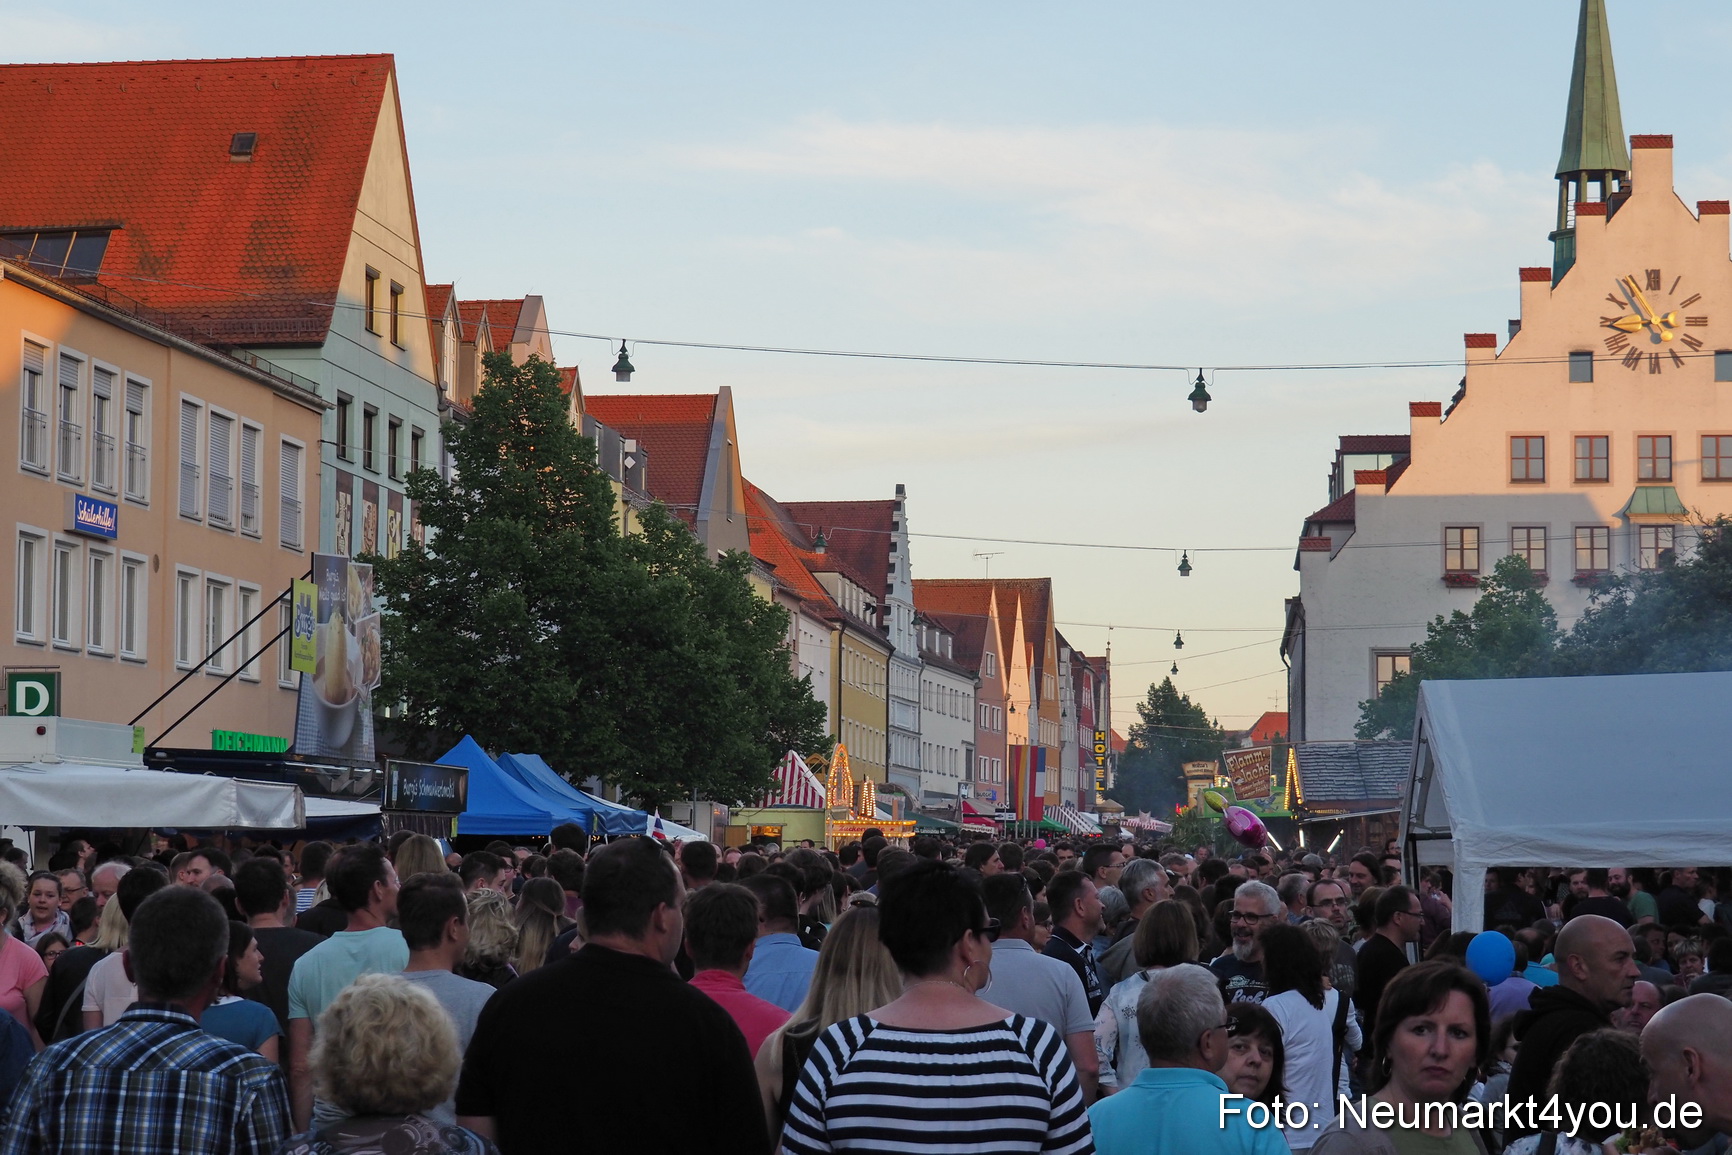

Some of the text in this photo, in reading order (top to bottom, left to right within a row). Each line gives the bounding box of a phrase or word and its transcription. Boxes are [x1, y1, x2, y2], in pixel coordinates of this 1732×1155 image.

[1645, 269, 1661, 291] XII
[1680, 293, 1702, 309] II
[1685, 316, 1708, 327] III
[16, 681, 50, 716] D
[213, 730, 289, 753] DEICHMANN
[1095, 731, 1106, 791] HOTEL
[1241, 763, 1270, 783] lachs
